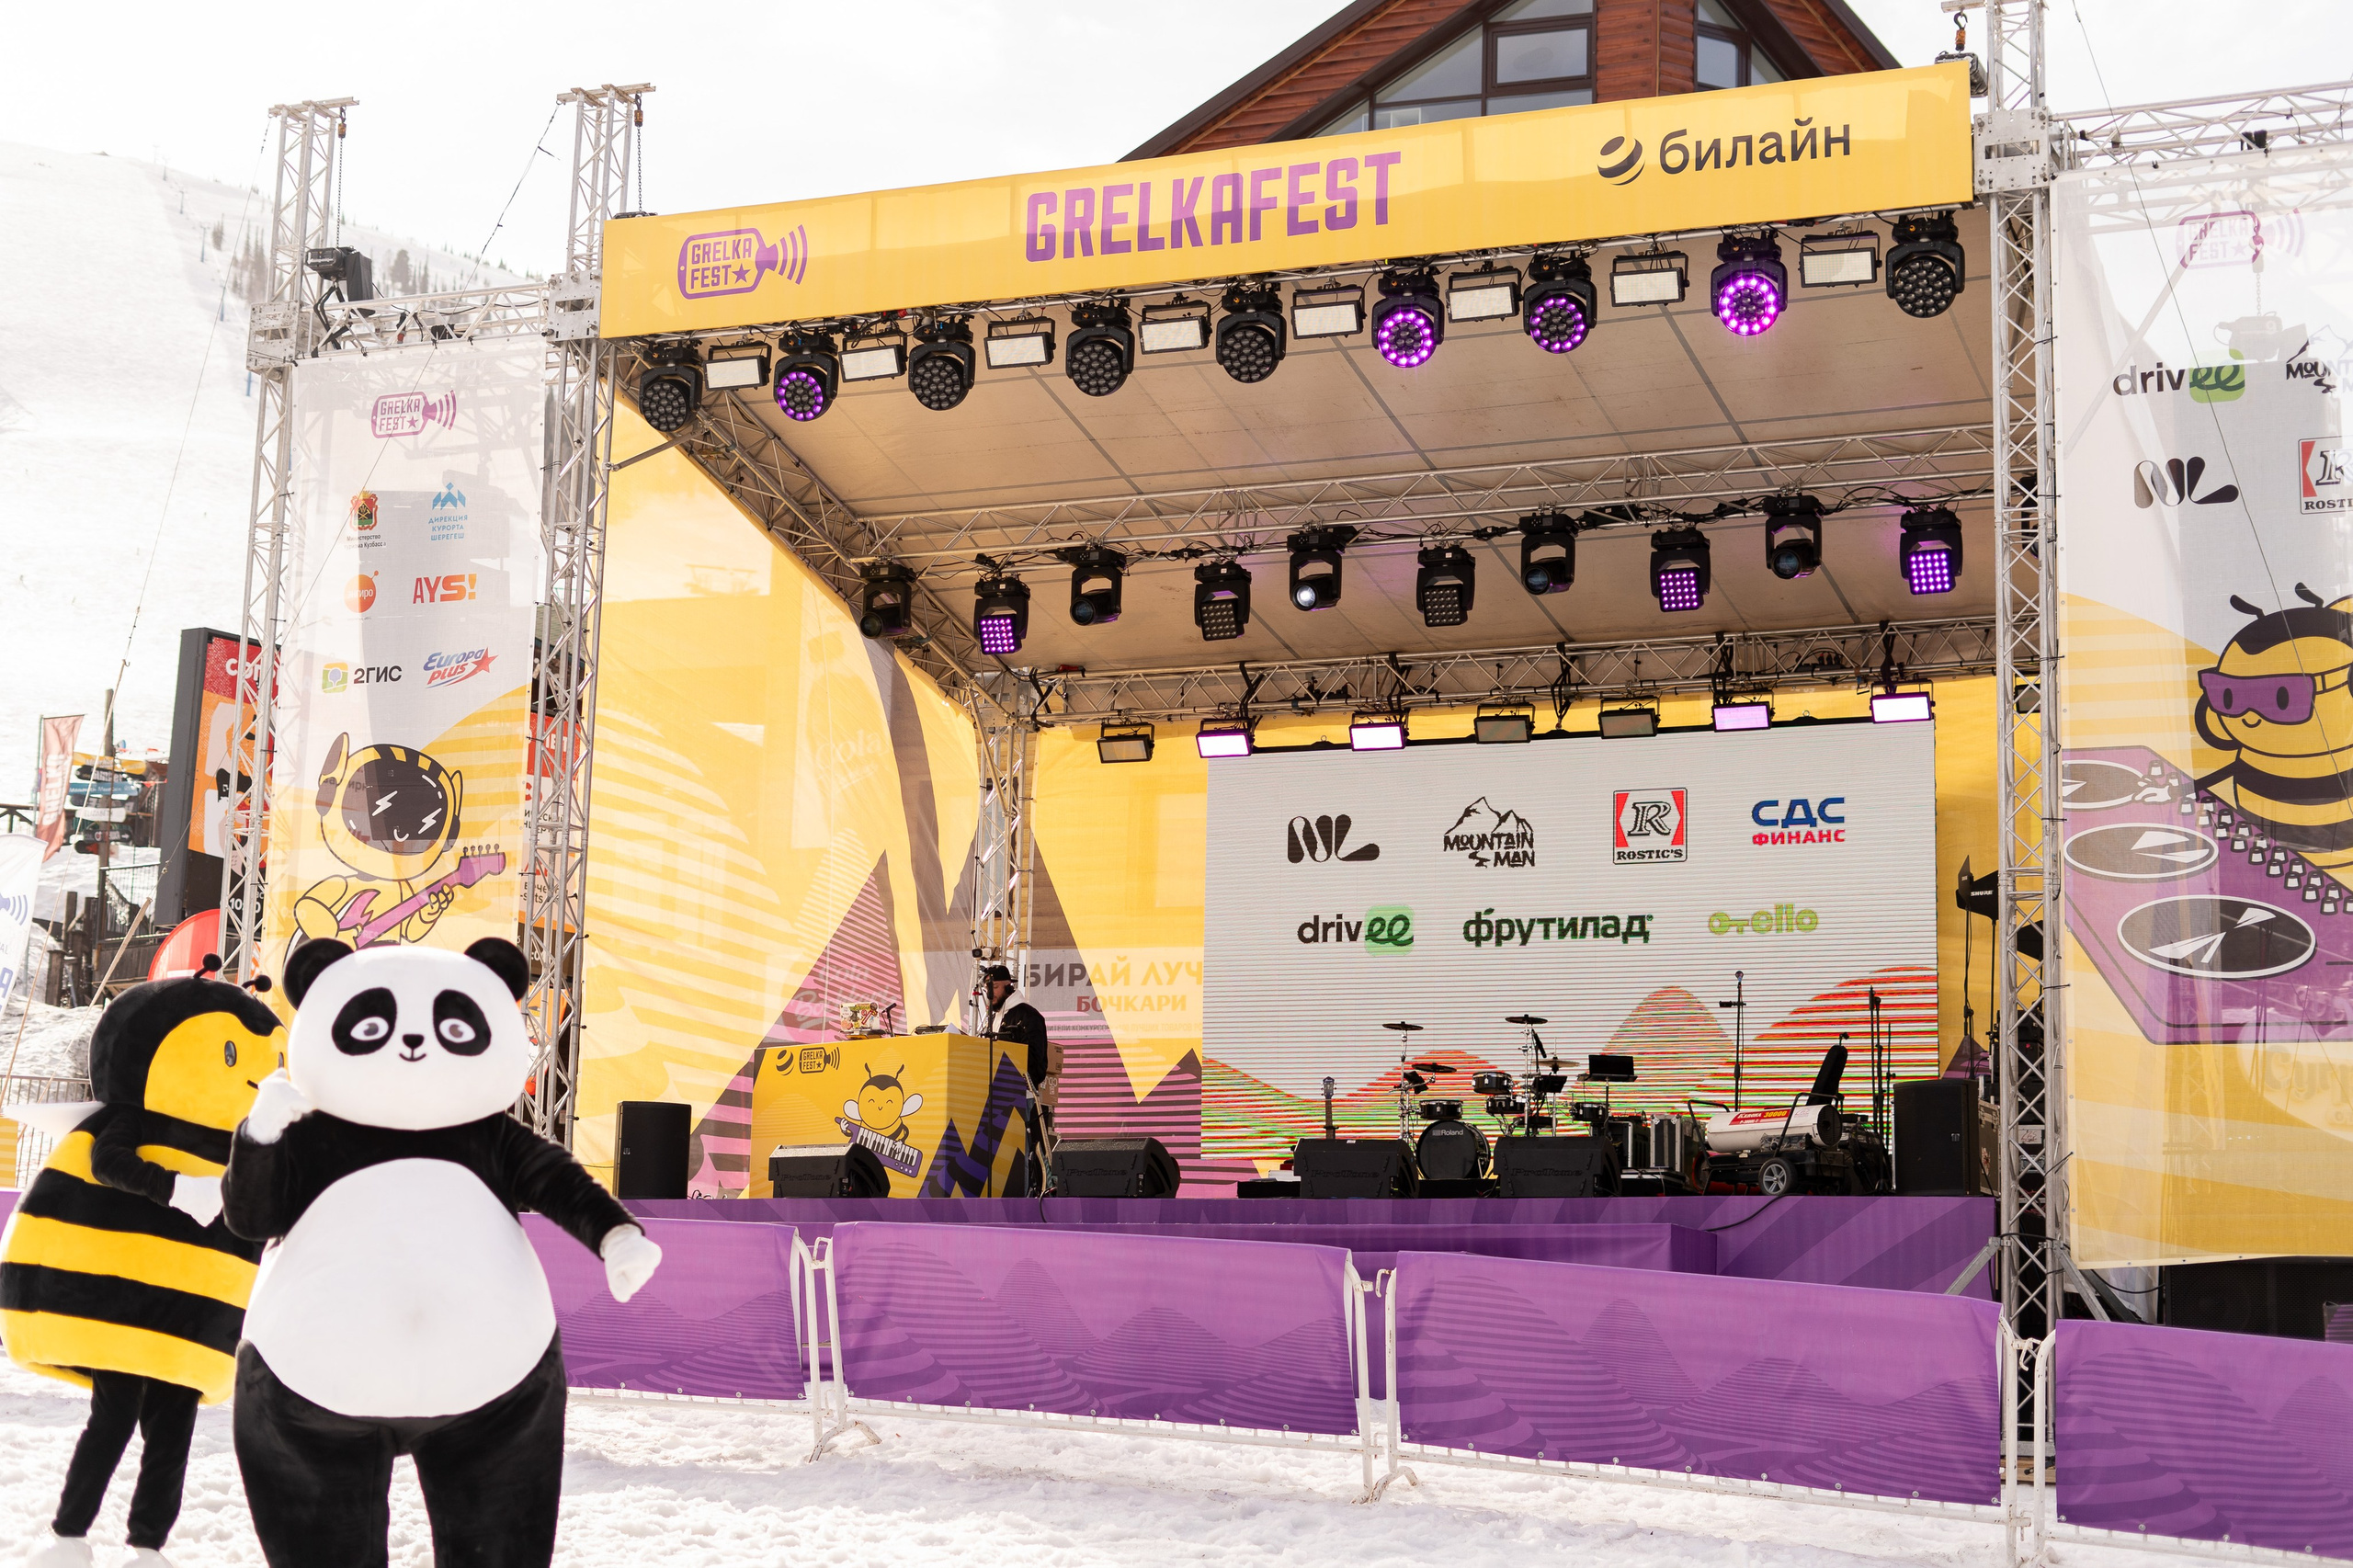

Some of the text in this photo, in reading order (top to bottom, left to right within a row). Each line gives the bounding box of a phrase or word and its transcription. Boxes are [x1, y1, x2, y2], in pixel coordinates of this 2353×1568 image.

[1659, 116, 1851, 176] билайн
[1025, 150, 1403, 264] GRELKAFEST
[2188, 219, 2249, 241] GRELKA
[691, 237, 752, 265] GRELKA
[2189, 241, 2230, 261] FEST
[690, 264, 732, 290] FEST
[2112, 360, 2245, 397] drivee
[380, 398, 421, 415] GRELKA
[379, 415, 407, 432] FEST
[428, 515, 469, 525] ДИРЕКЦИЯ
[432, 524, 464, 532] КУРОРТА
[430, 532, 465, 541] ШЕРЕГЕШ
[413, 573, 477, 605] AYS!
[353, 665, 403, 685] 2ГИС
[1752, 796, 1846, 829] СДС
[1443, 832, 1535, 852] MOUNTAIN
[1752, 829, 1846, 846] ФИНАНС
[1493, 850, 1536, 868] MAN
[1616, 848, 1684, 861] ROSTIC'S
[1297, 913, 1415, 947] drivee
[1076, 994, 1188, 1013] БОЧКАРИ
[802, 1050, 824, 1061] GRELKA
[802, 1060, 817, 1071] FEST
[1440, 1129, 1464, 1137] Roland
